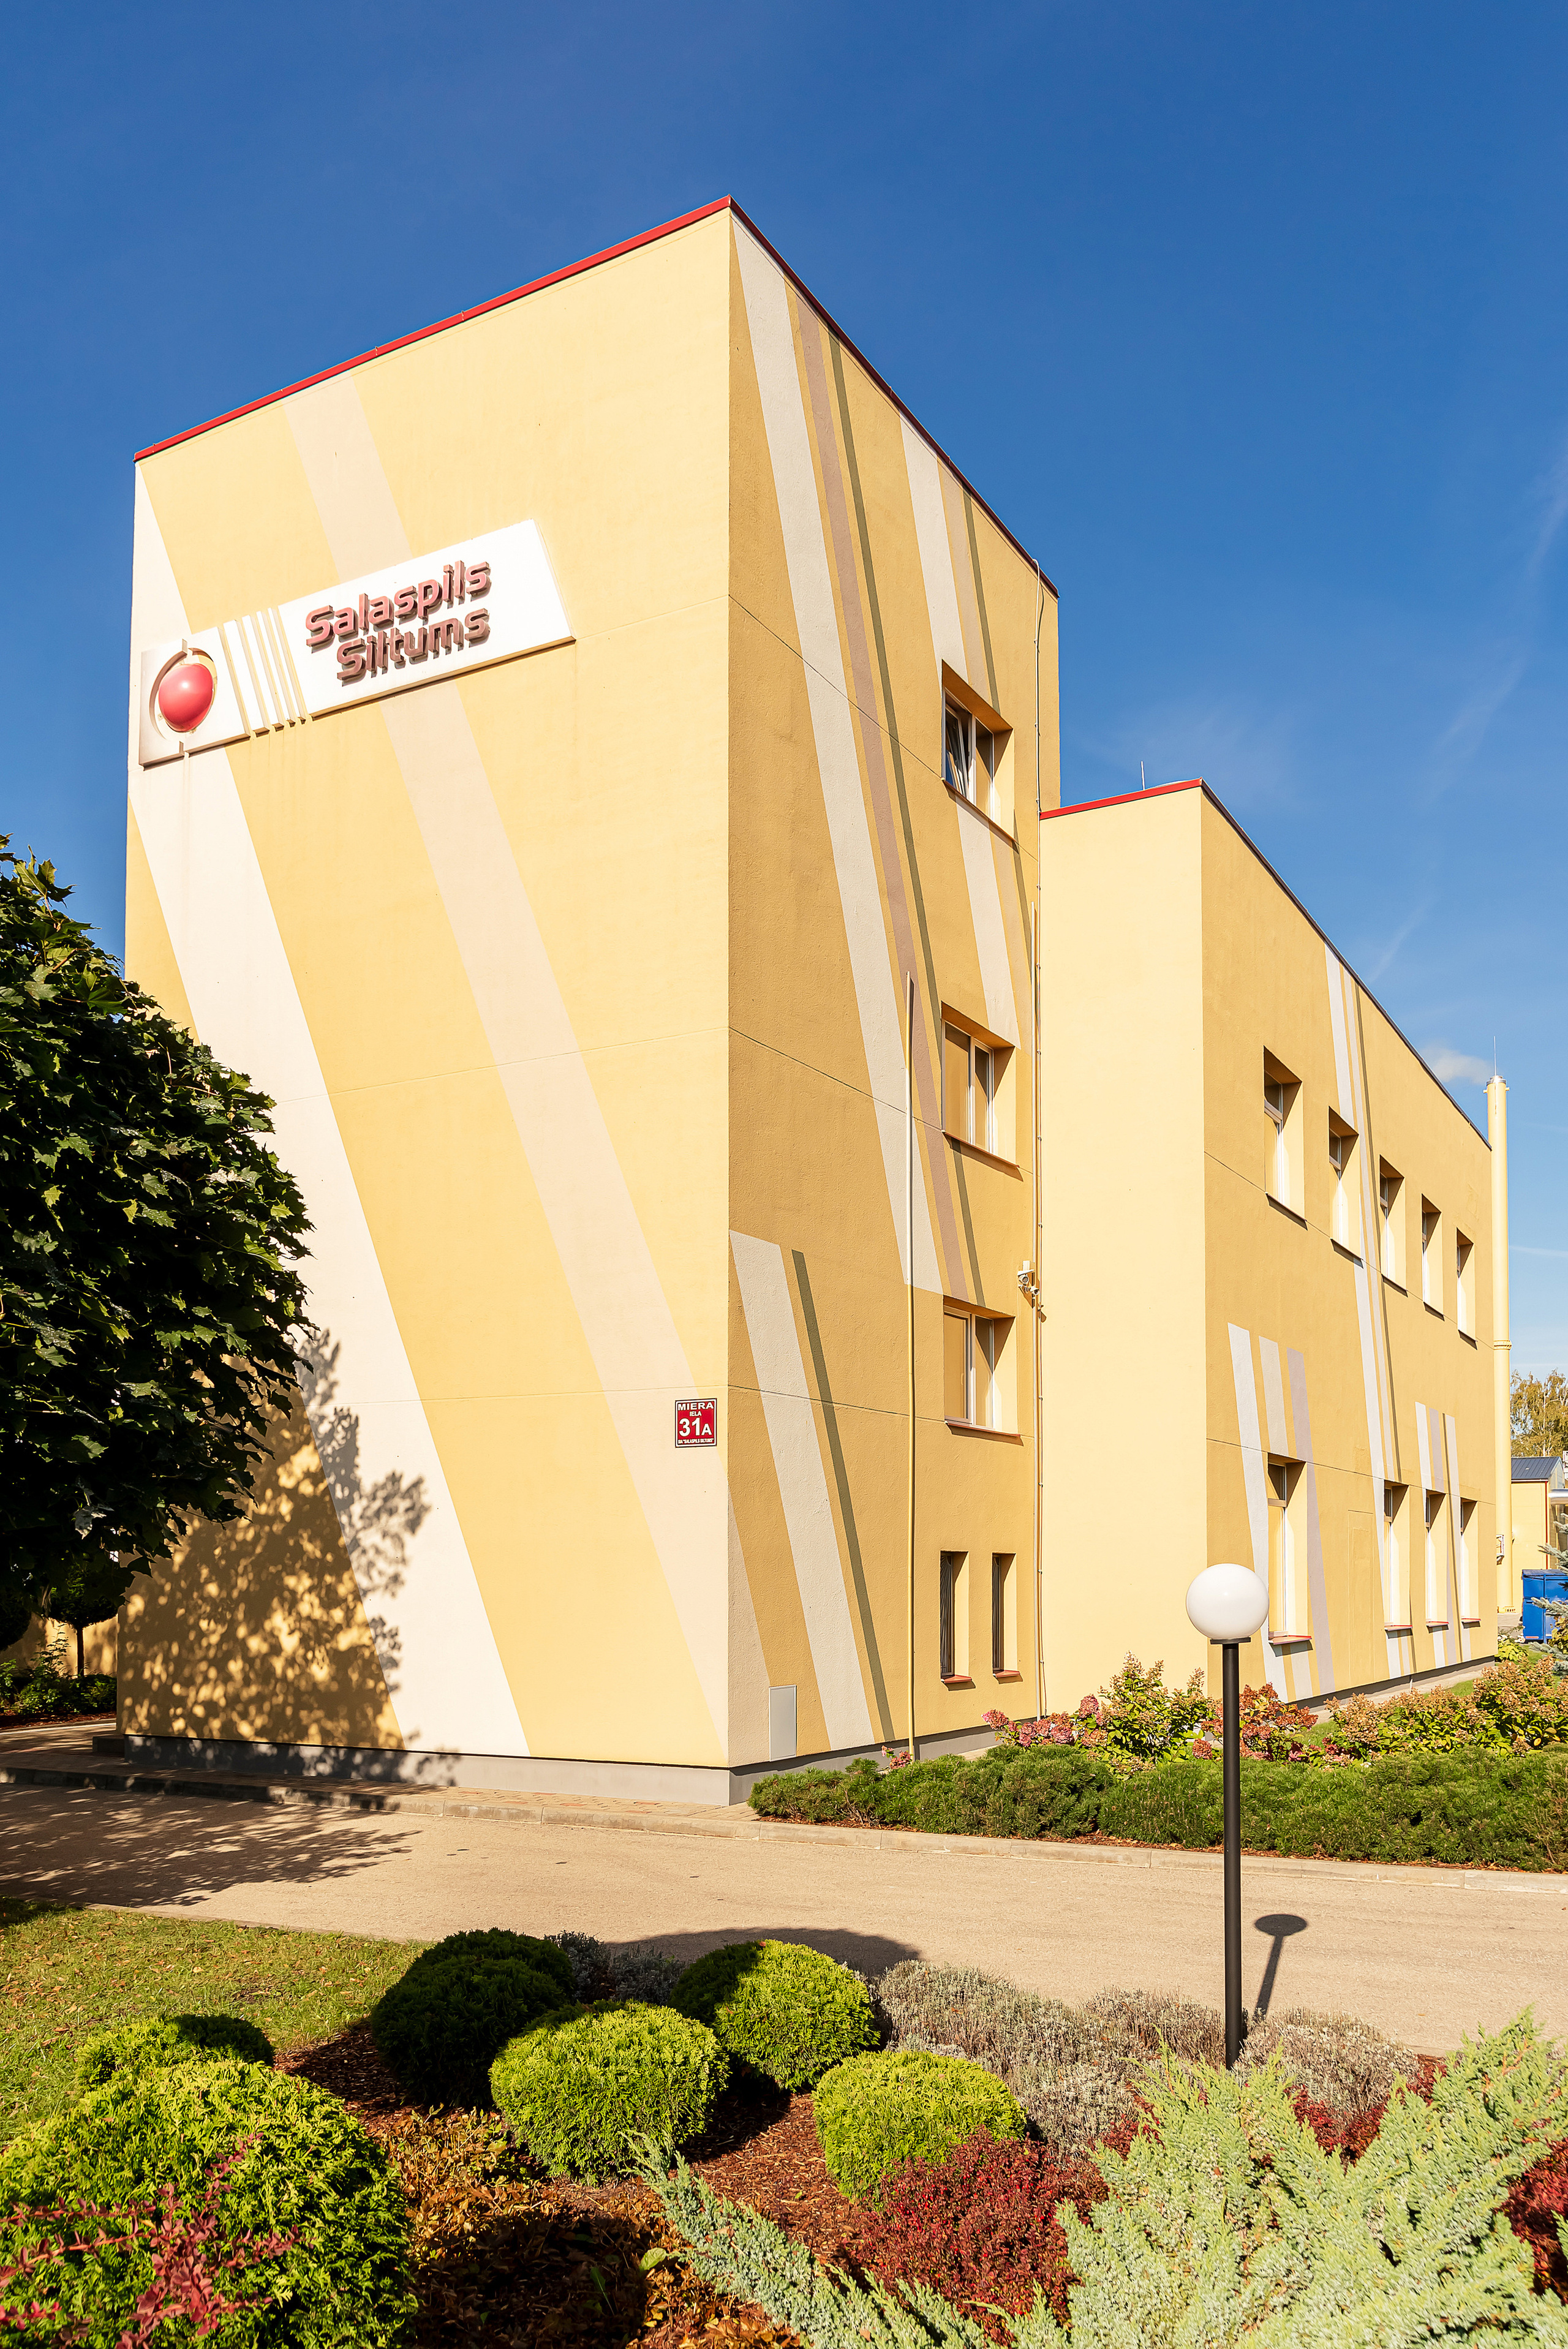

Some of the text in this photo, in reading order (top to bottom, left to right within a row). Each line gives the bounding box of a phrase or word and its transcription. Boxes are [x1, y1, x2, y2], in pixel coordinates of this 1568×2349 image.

[306, 560, 491, 650] Salaspils
[336, 608, 490, 685] Siltums
[677, 1401, 714, 1411] MIERA
[679, 1417, 712, 1437] 31A
